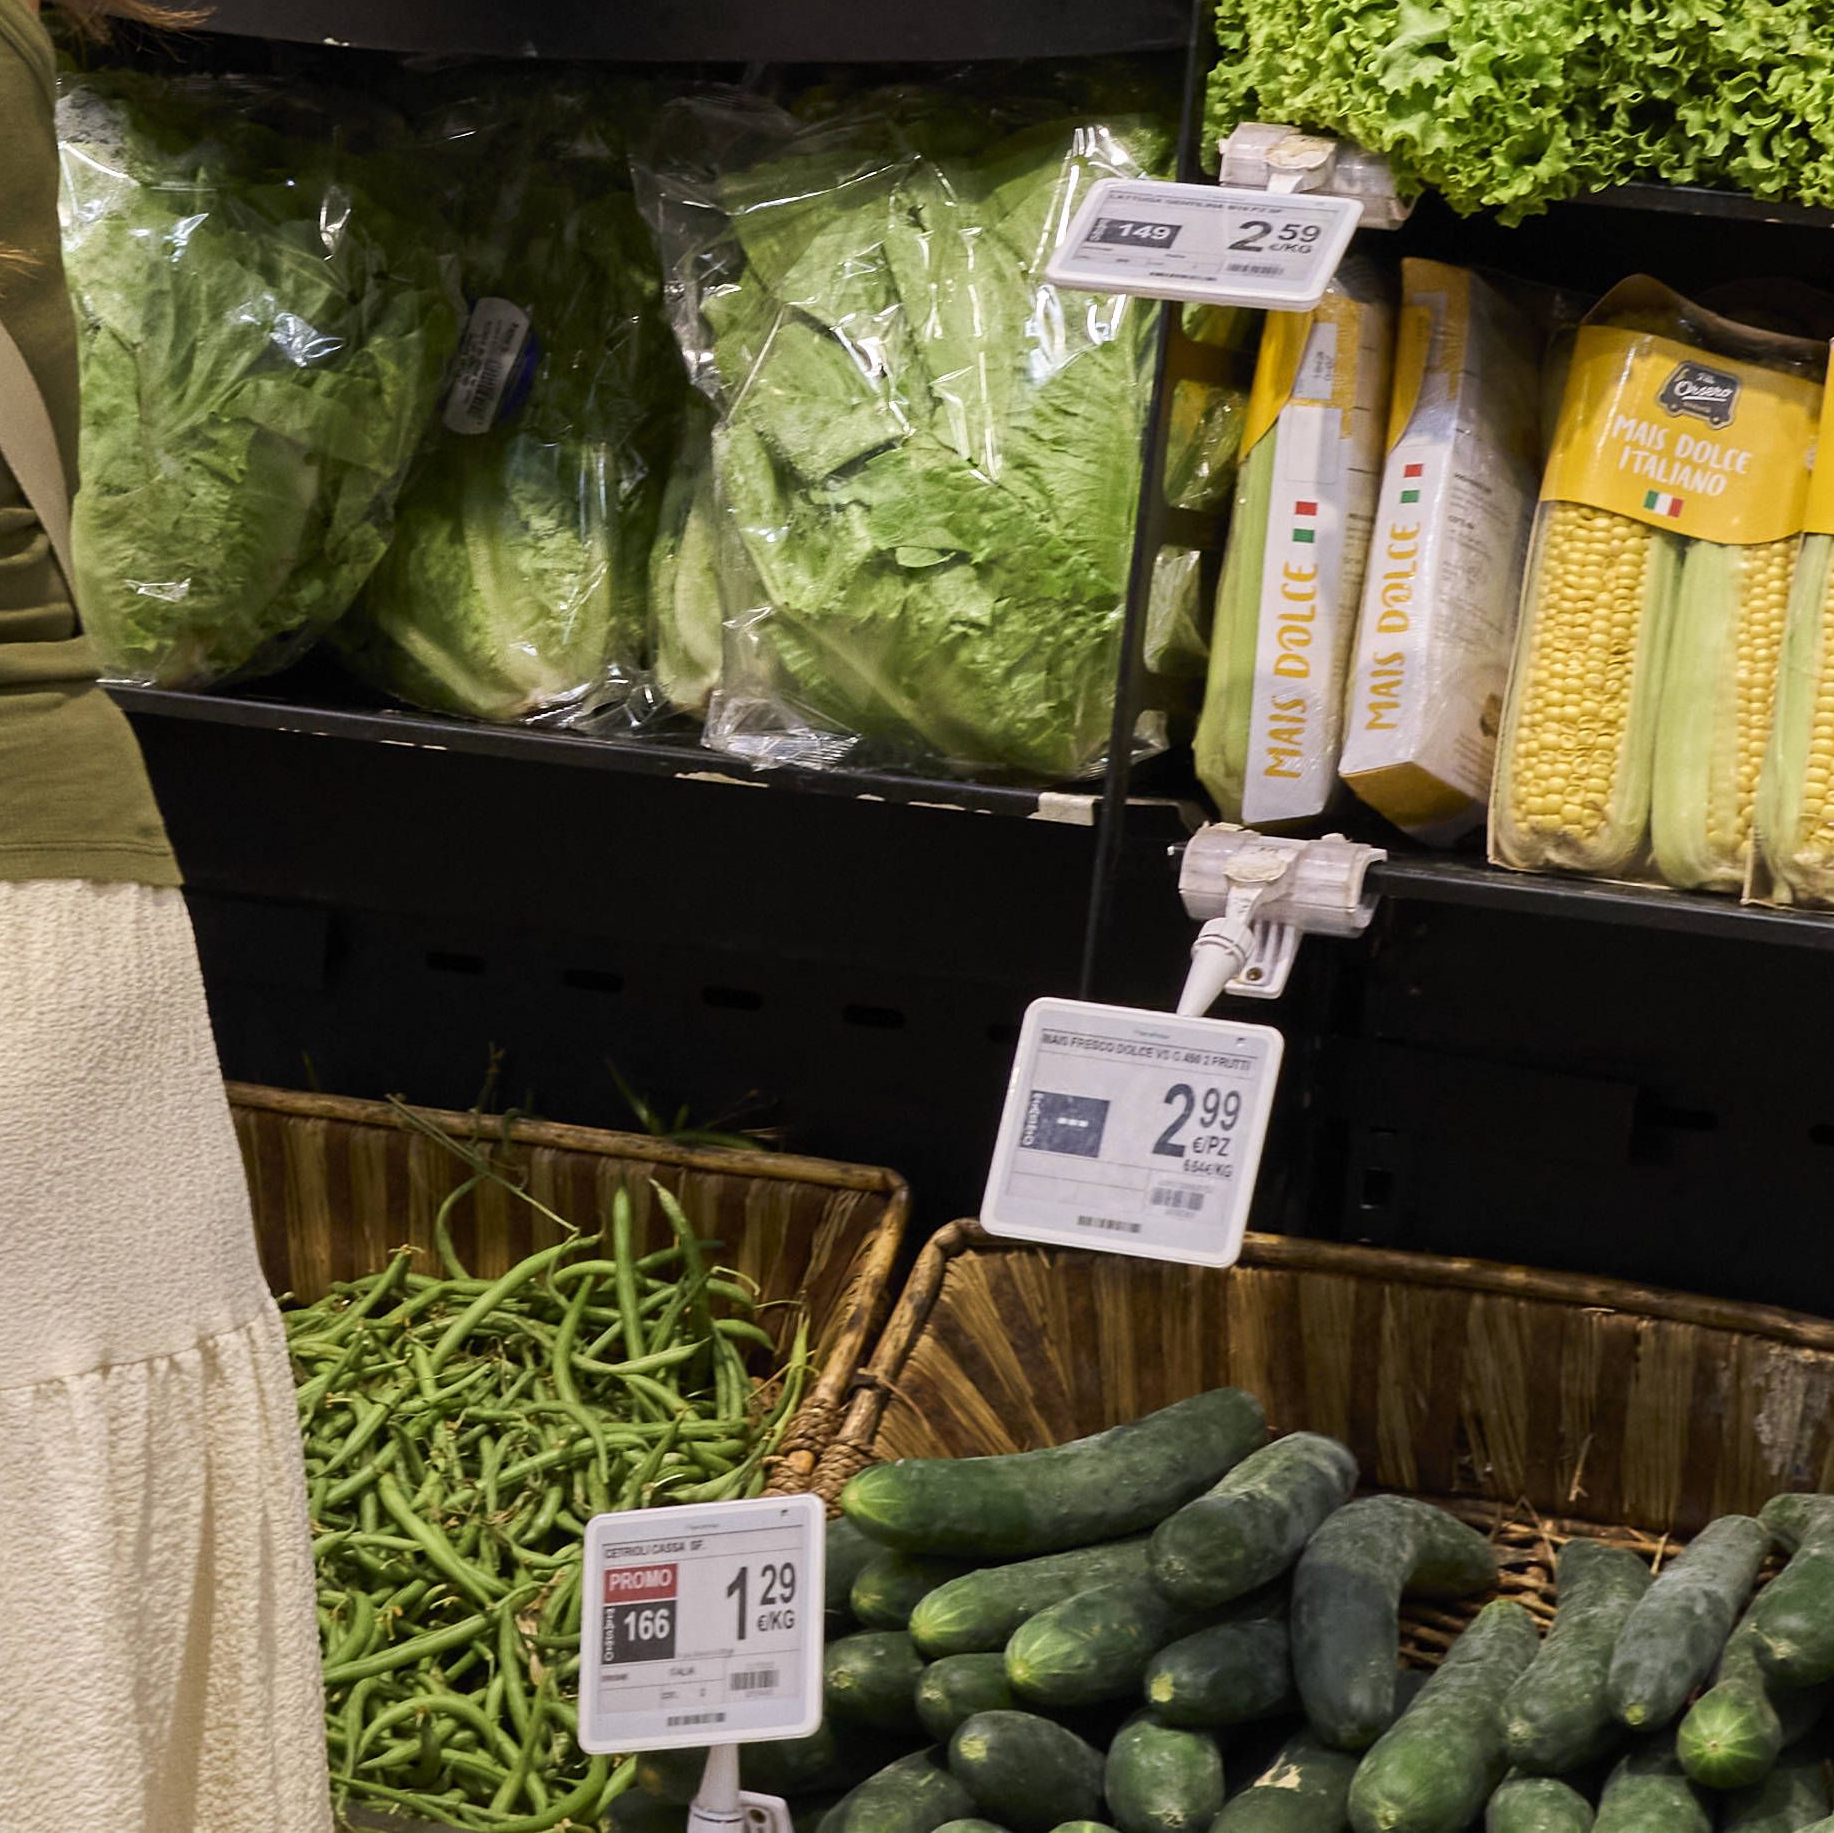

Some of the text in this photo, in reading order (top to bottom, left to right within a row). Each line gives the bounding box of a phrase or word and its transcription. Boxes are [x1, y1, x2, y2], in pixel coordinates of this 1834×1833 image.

[1117, 222, 1171, 241] 149
[1228, 219, 1322, 253] 2 59
[1673, 380, 1734, 398] Orsero
[1612, 414, 1752, 474] MAIS DOLCE
[1619, 446, 1728, 497] ITALIANO
[1365, 520, 1422, 731] MAIS DOLCE
[1264, 560, 1319, 779] MAIS DOLCE
[1068, 1035, 1114, 1055] FRESCO
[1115, 1041, 1154, 1060] DOLCE
[1152, 1082, 1242, 1159] 2 99
[1193, 1136, 1231, 1158] €/PZ
[604, 1542, 649, 1560] CETRIOLI
[652, 1539, 687, 1556] CASSA
[608, 1570, 673, 1591] PROMO
[726, 1561, 796, 1641] 1 29
[623, 1609, 671, 1642] 166
[757, 1609, 796, 1633] €/KG
